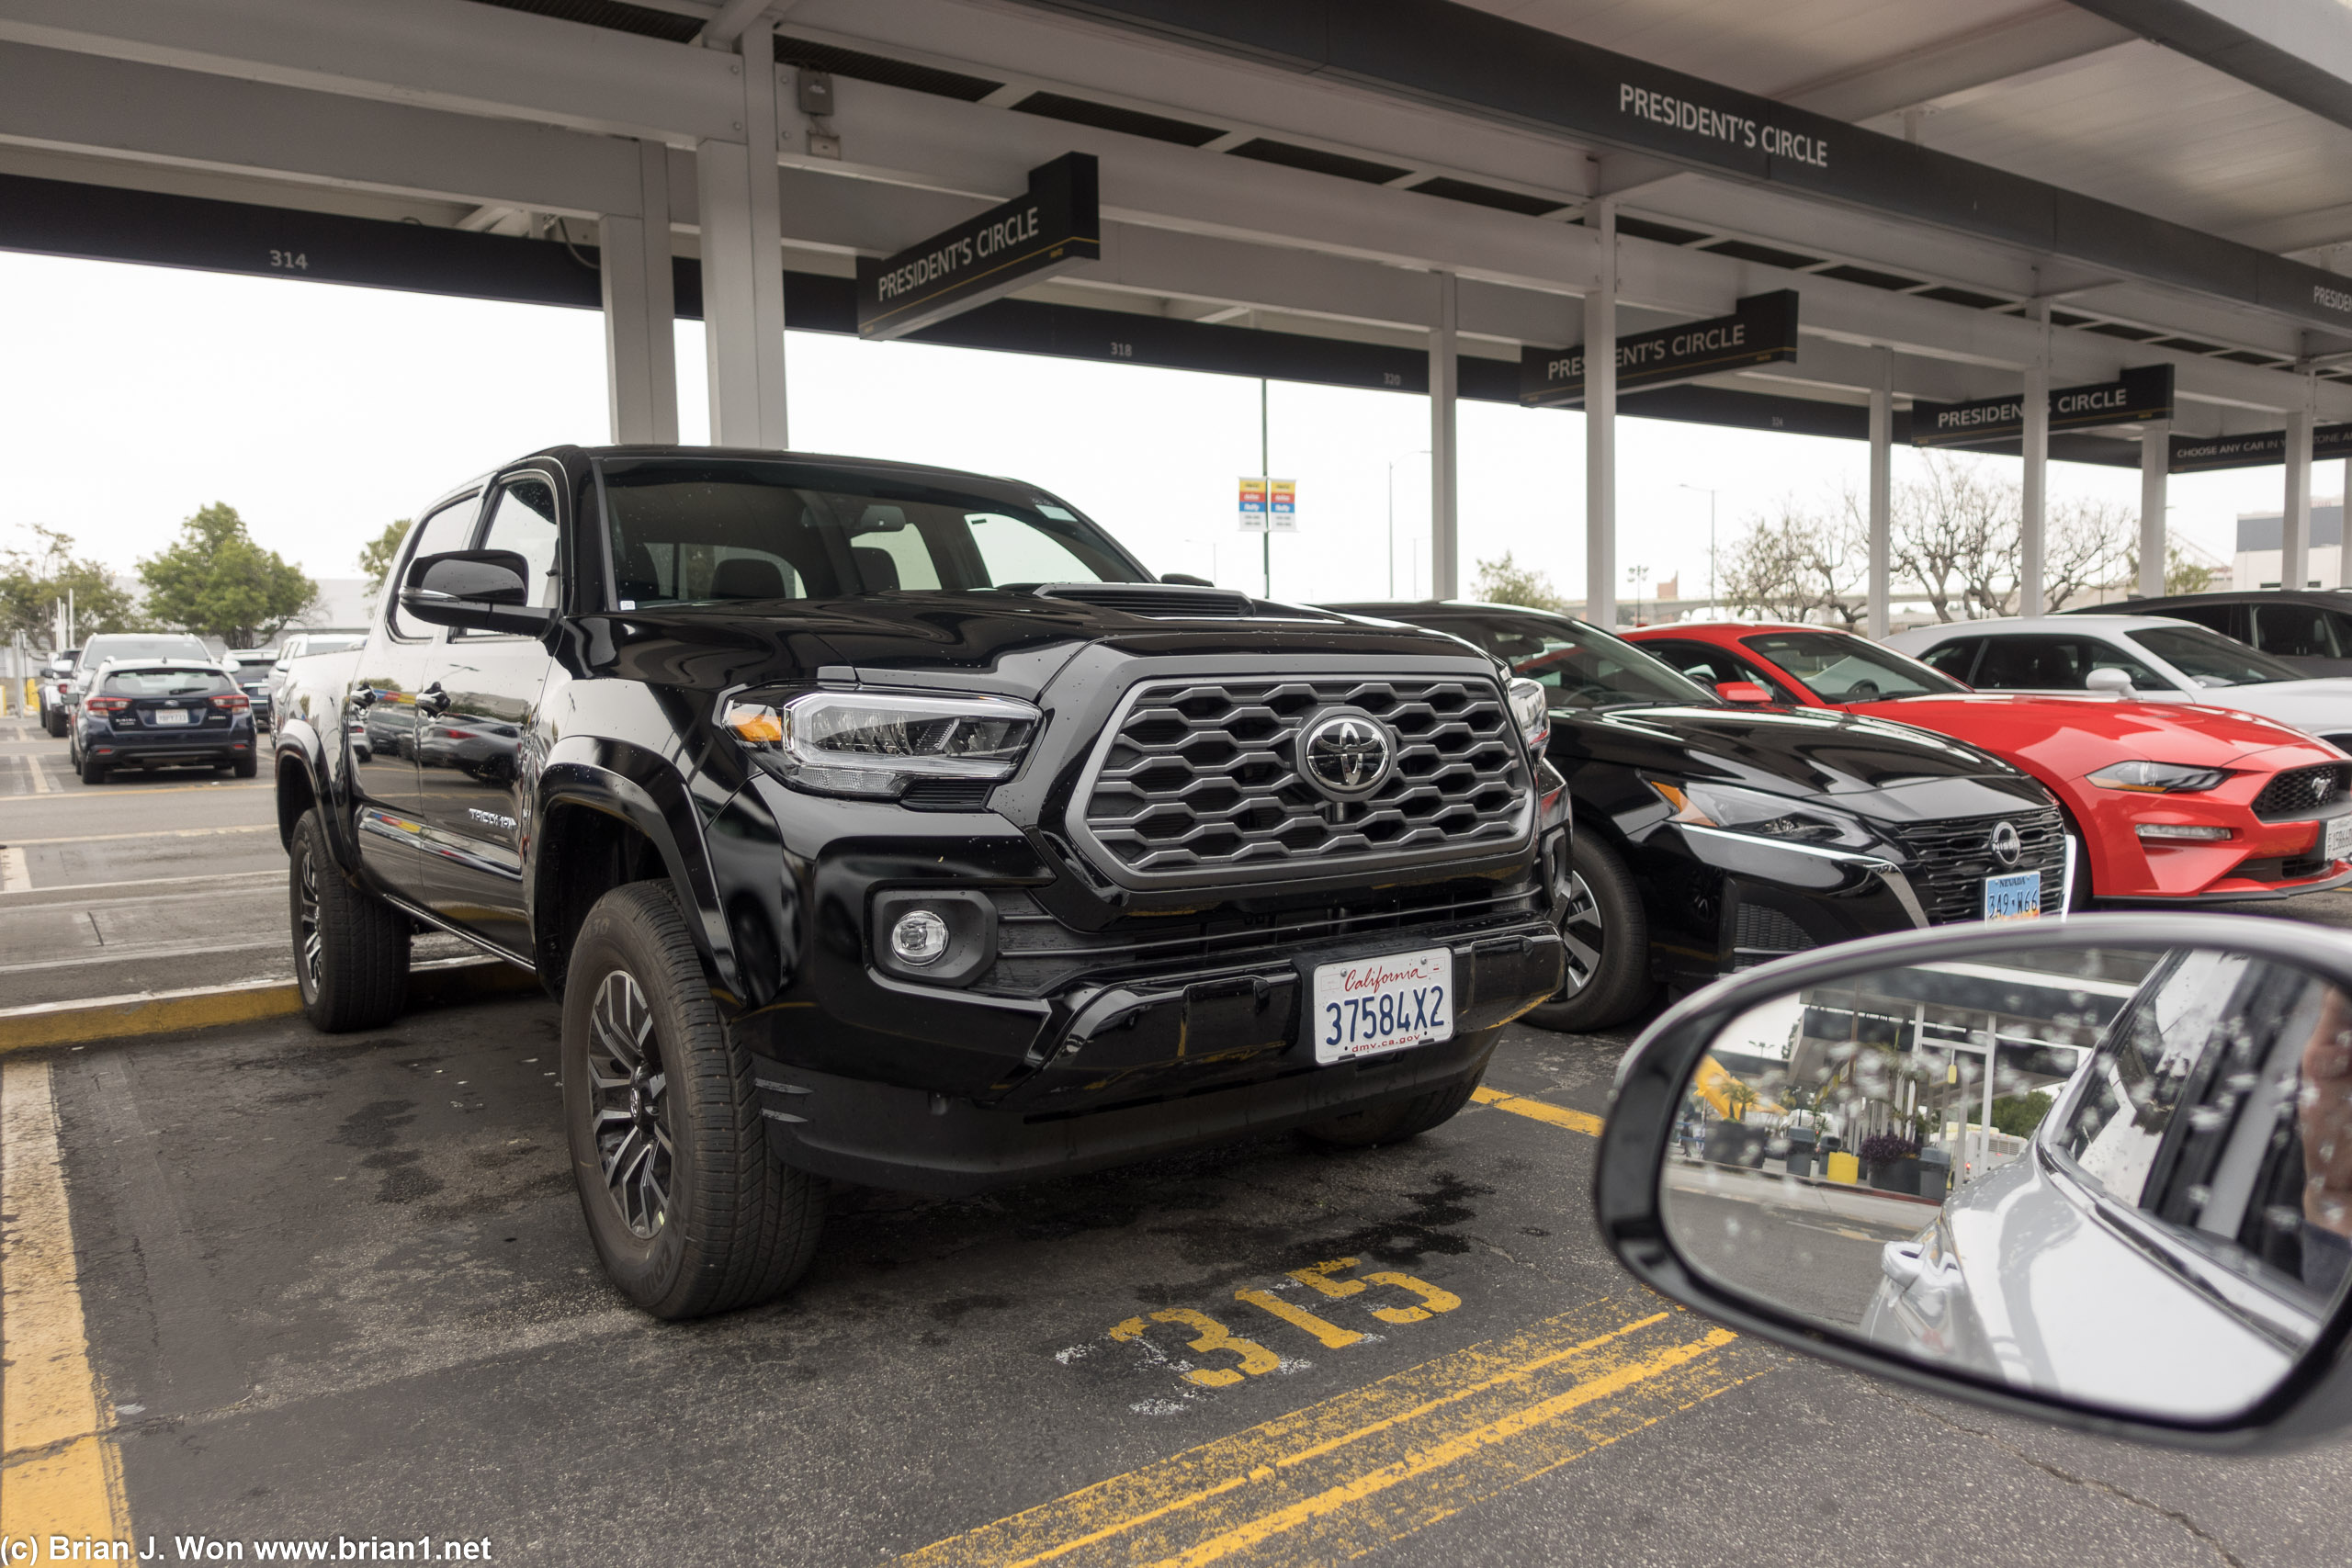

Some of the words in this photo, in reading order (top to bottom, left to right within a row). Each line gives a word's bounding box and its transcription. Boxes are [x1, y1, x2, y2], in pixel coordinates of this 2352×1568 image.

[1619, 83, 1756, 149] PRESIDENT'S
[1761, 125, 1828, 167] CIRCLE
[269, 249, 309, 269] 314
[878, 237, 973, 302] PRESIDENT'S
[977, 207, 1040, 258] CIRCLE
[1110, 342, 1132, 357] 318
[1671, 324, 1746, 356] CIRCLE
[2058, 389, 2127, 412] CIRCLE
[2177, 446, 2218, 458] CHOOSE
[2219, 442, 2241, 454] ANY
[2243, 441, 2265, 452] CAR
[2267, 438, 2278, 449] IN
[1999, 876, 2026, 887] NEVADA
[1344, 965, 1428, 993] California
[1326, 986, 1445, 1046] 37584X2
[1351, 1034, 1420, 1053] dmv.ca.gov
[1108, 1256, 1463, 1388] 315
